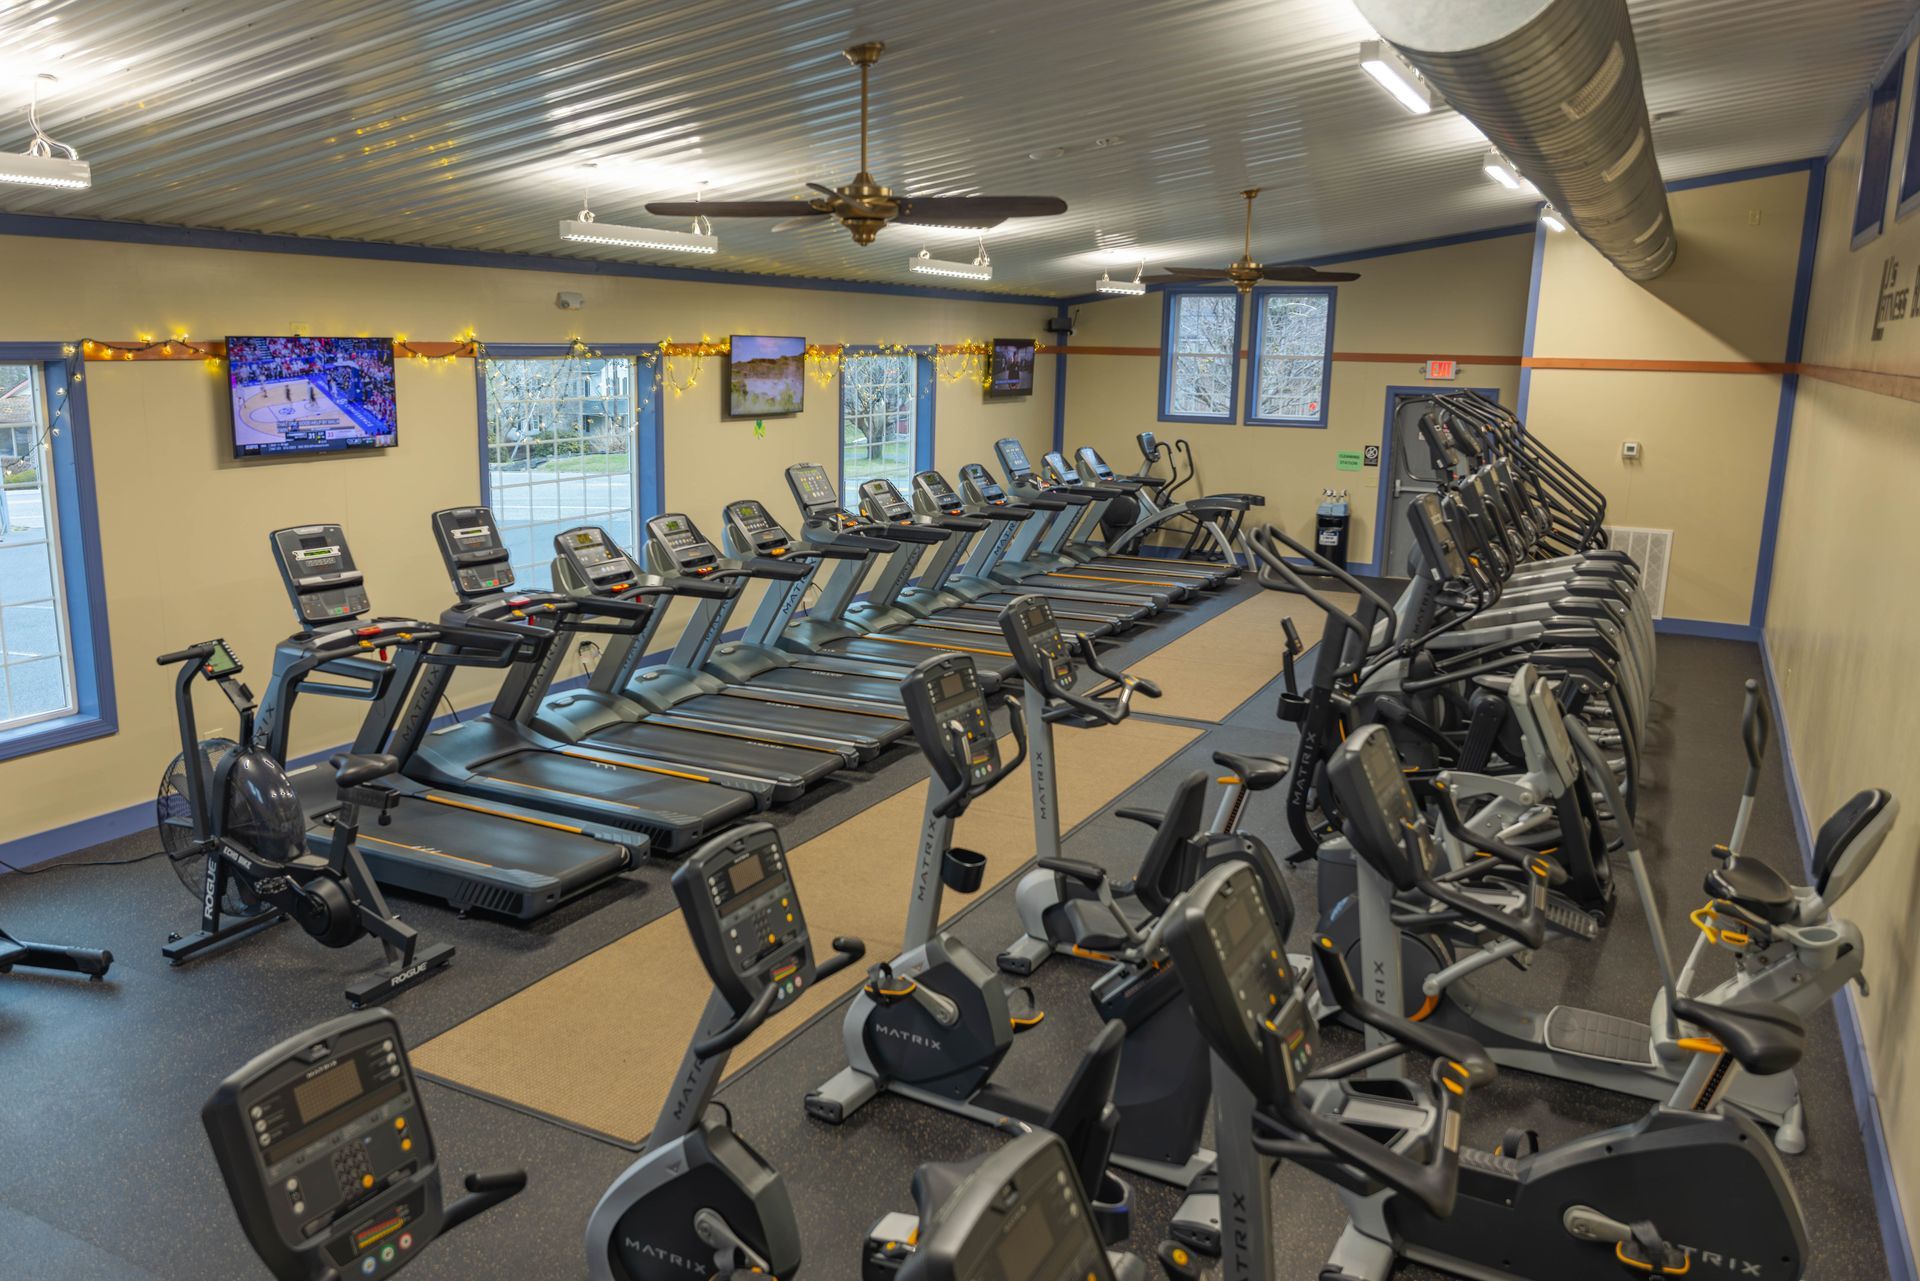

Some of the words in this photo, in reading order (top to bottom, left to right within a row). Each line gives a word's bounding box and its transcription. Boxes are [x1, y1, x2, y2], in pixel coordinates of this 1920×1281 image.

[1431, 361, 1452, 377] EXIT
[402, 666, 440, 742] MATRIX
[1036, 752, 1048, 820] MATRIX
[1292, 731, 1316, 806] MATRIX
[223, 846, 239, 861] ECHO
[918, 818, 936, 901] MATRIX
[204, 858, 217, 920] ROGUE
[391, 961, 428, 987] ROGUE
[876, 1023, 941, 1051] MATRIX
[673, 1058, 706, 1121] MATR
[625, 1236, 707, 1275] MATRIX
[1232, 1192, 1249, 1281] TRIX
[1676, 1243, 1763, 1278] TRIX
